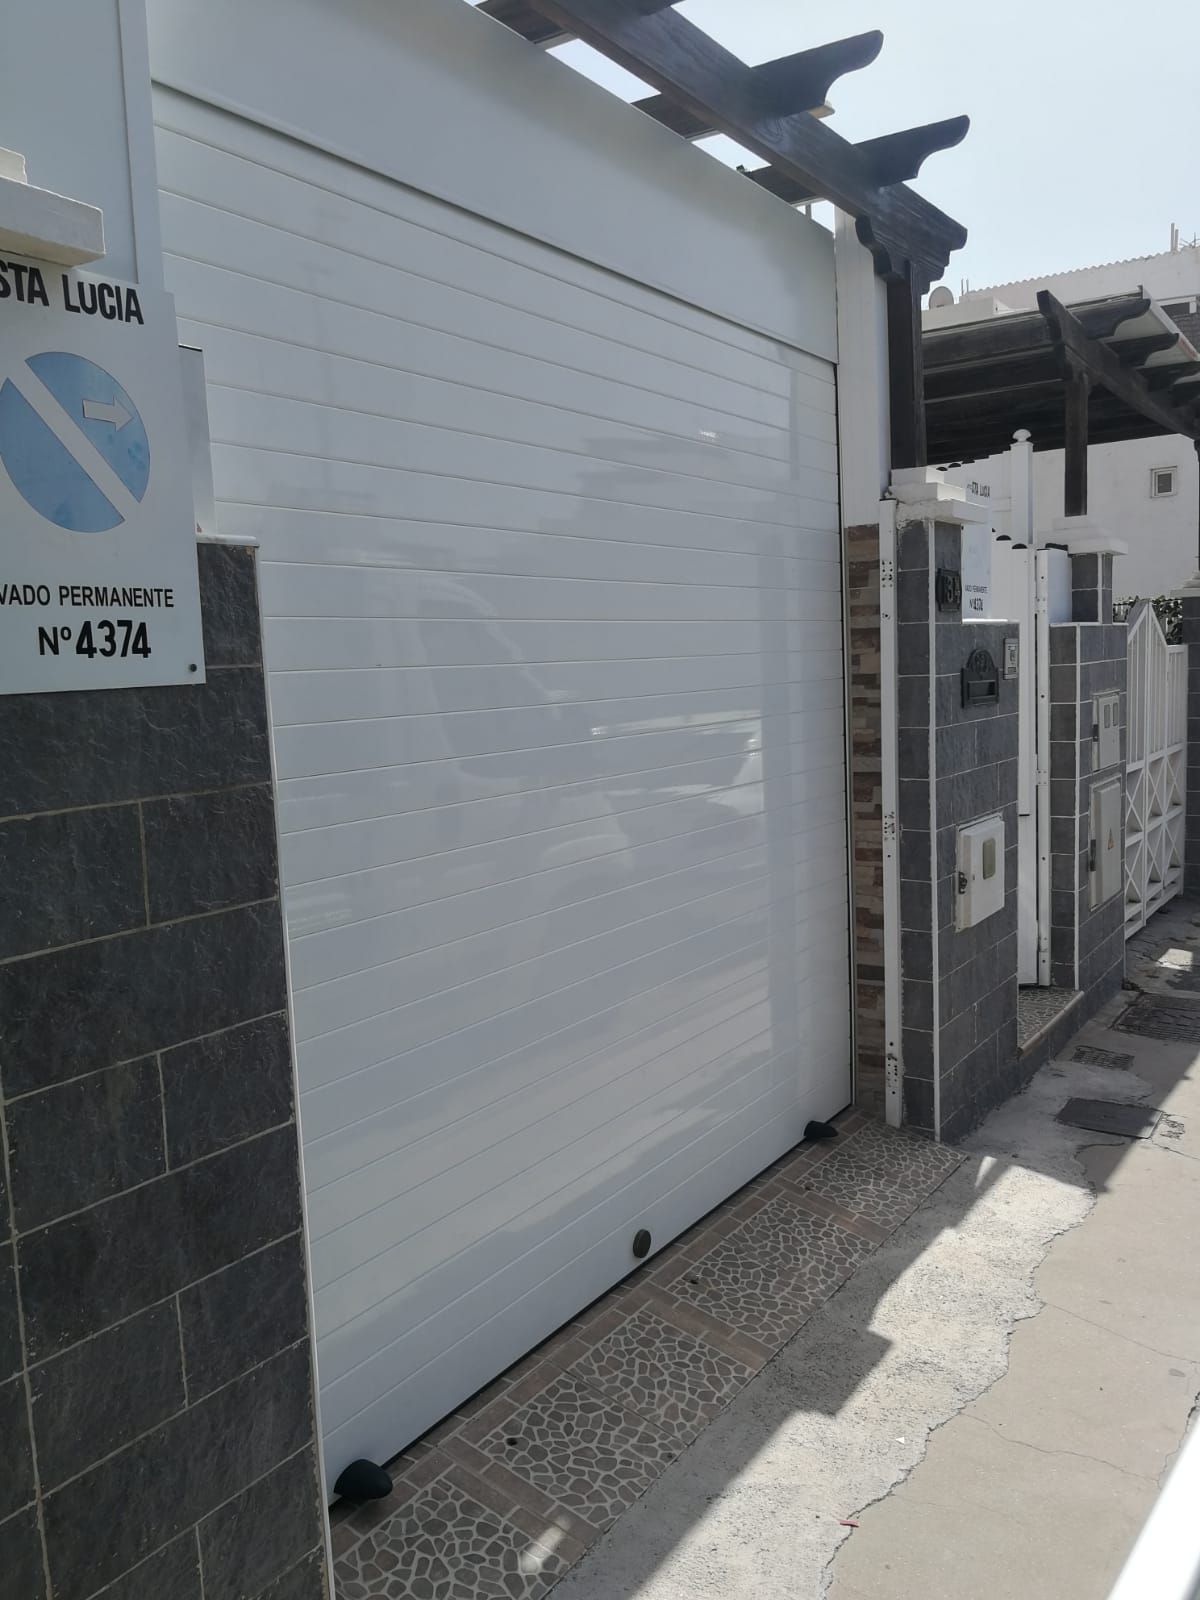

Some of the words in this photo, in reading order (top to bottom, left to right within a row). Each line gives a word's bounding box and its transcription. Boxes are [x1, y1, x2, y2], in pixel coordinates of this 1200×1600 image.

[0, 259, 50, 307] STA
[62, 273, 145, 325] LUCIA
[0, 583, 51, 606] VADO
[59, 585, 175, 608] PERMANENTE
